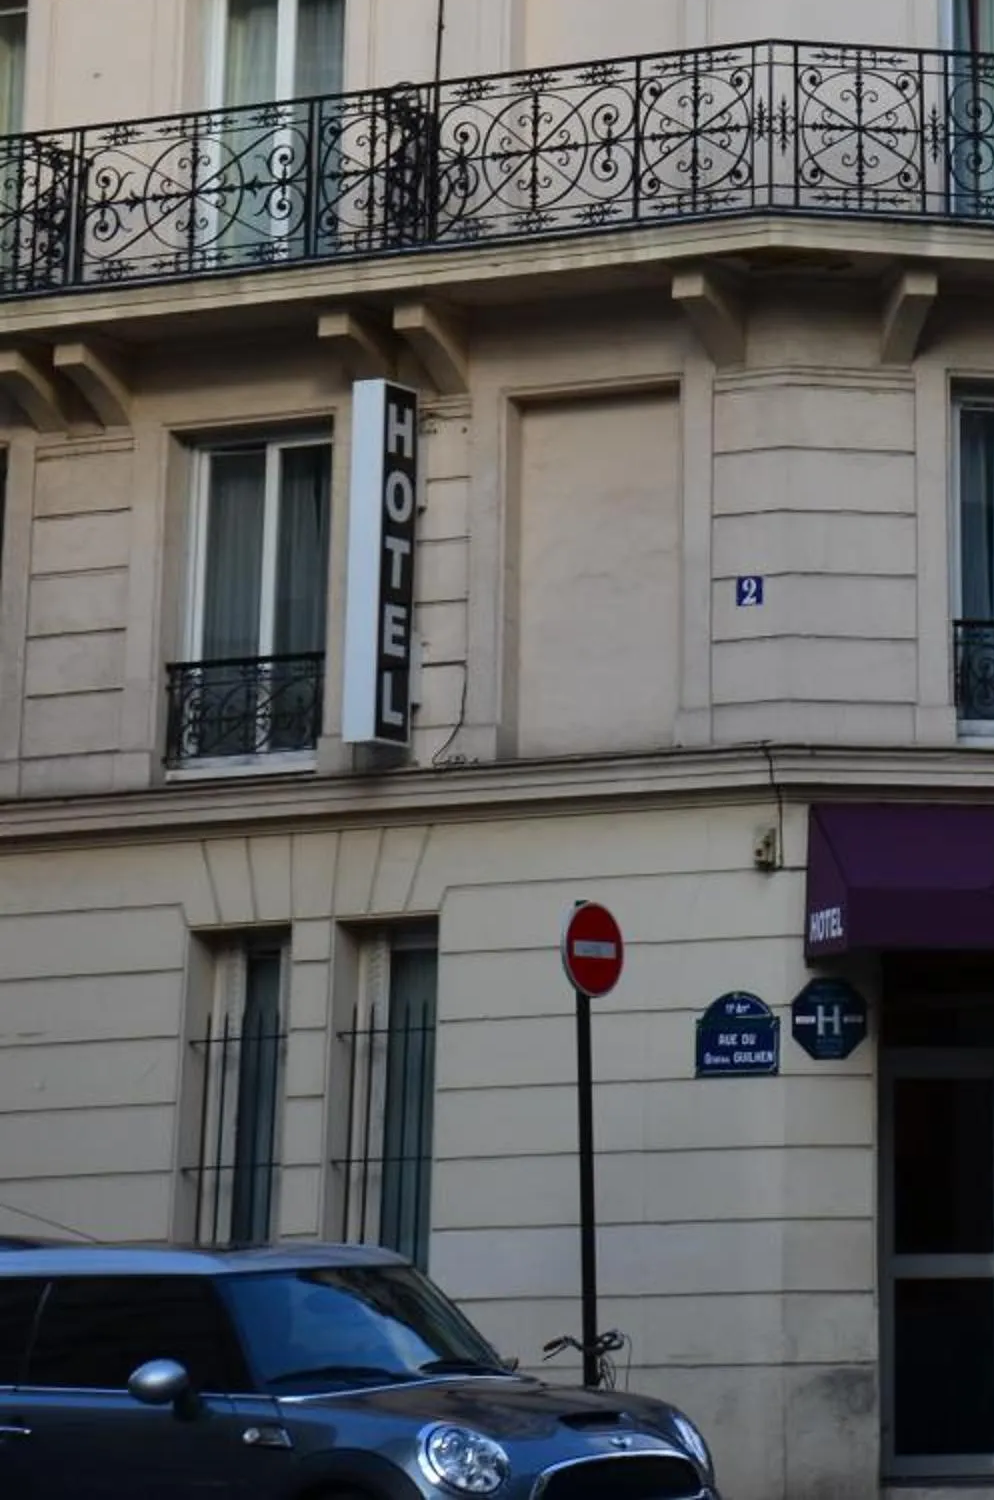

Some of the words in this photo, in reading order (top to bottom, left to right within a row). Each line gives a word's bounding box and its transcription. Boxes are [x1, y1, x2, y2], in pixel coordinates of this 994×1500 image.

[381, 402, 414, 726] HOTEL
[742, 578, 757, 605] 2
[809, 907, 844, 943] HOTEL
[816, 1004, 841, 1036] H
[717, 1033, 738, 1046] RUE
[740, 1033, 757, 1046] DU
